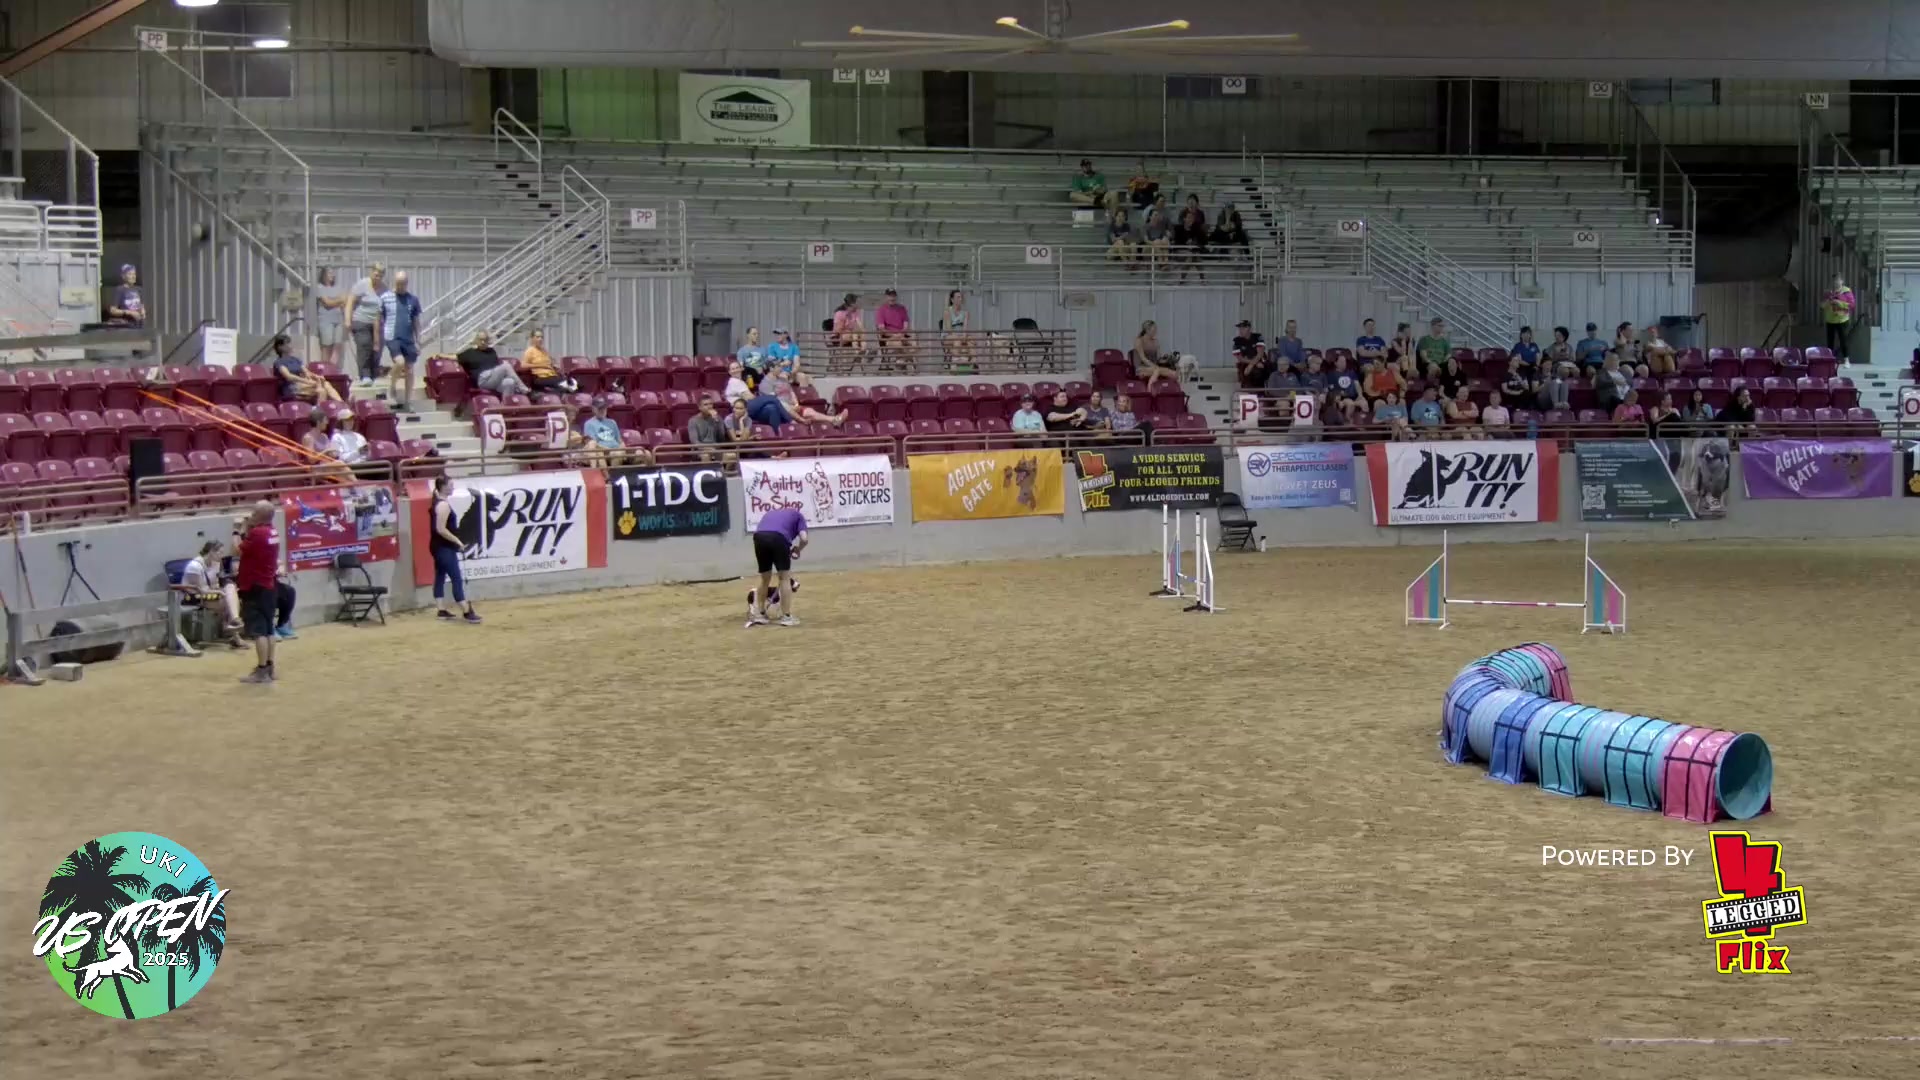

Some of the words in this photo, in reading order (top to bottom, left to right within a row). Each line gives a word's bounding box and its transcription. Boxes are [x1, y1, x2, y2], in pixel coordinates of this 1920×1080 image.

[713, 102, 731, 111] THE
[415, 217, 433, 230] PP
[636, 210, 653, 223] PP
[813, 244, 831, 257] PP
[1241, 398, 1258, 421] P
[1296, 400, 1313, 419] O
[488, 418, 504, 440] Q
[551, 416, 567, 443] P
[1132, 455, 1139, 464] A
[1139, 454, 1166, 463] VIDEO
[1167, 453, 1206, 462] SERVICE
[1137, 466, 1155, 475] FOR
[1156, 465, 1173, 474] ALL
[1176, 464, 1201, 474] YOUR
[1271, 463, 1322, 473] THERAPEUTIC
[1322, 463, 1348, 472] LASERS
[1454, 451, 1534, 482] RUN
[1775, 442, 1825, 478] AGILITY
[759, 470, 804, 495] Agility
[946, 458, 996, 497] AGILITY
[1119, 477, 1179, 488] FOUR-LEGGED
[1180, 476, 1220, 486] FRIENDS
[1311, 479, 1337, 489] ZEUS
[1788, 461, 1820, 492] GATE
[501, 485, 583, 525] RUN
[961, 478, 993, 513] GATE
[1464, 482, 1526, 510] IT!
[639, 511, 675, 530] works
[692, 506, 719, 527] well
[1391, 514, 1424, 523] ULTIMATE
[1467, 512, 1506, 520] EQUIPMENT
[514, 522, 574, 557] IT!
